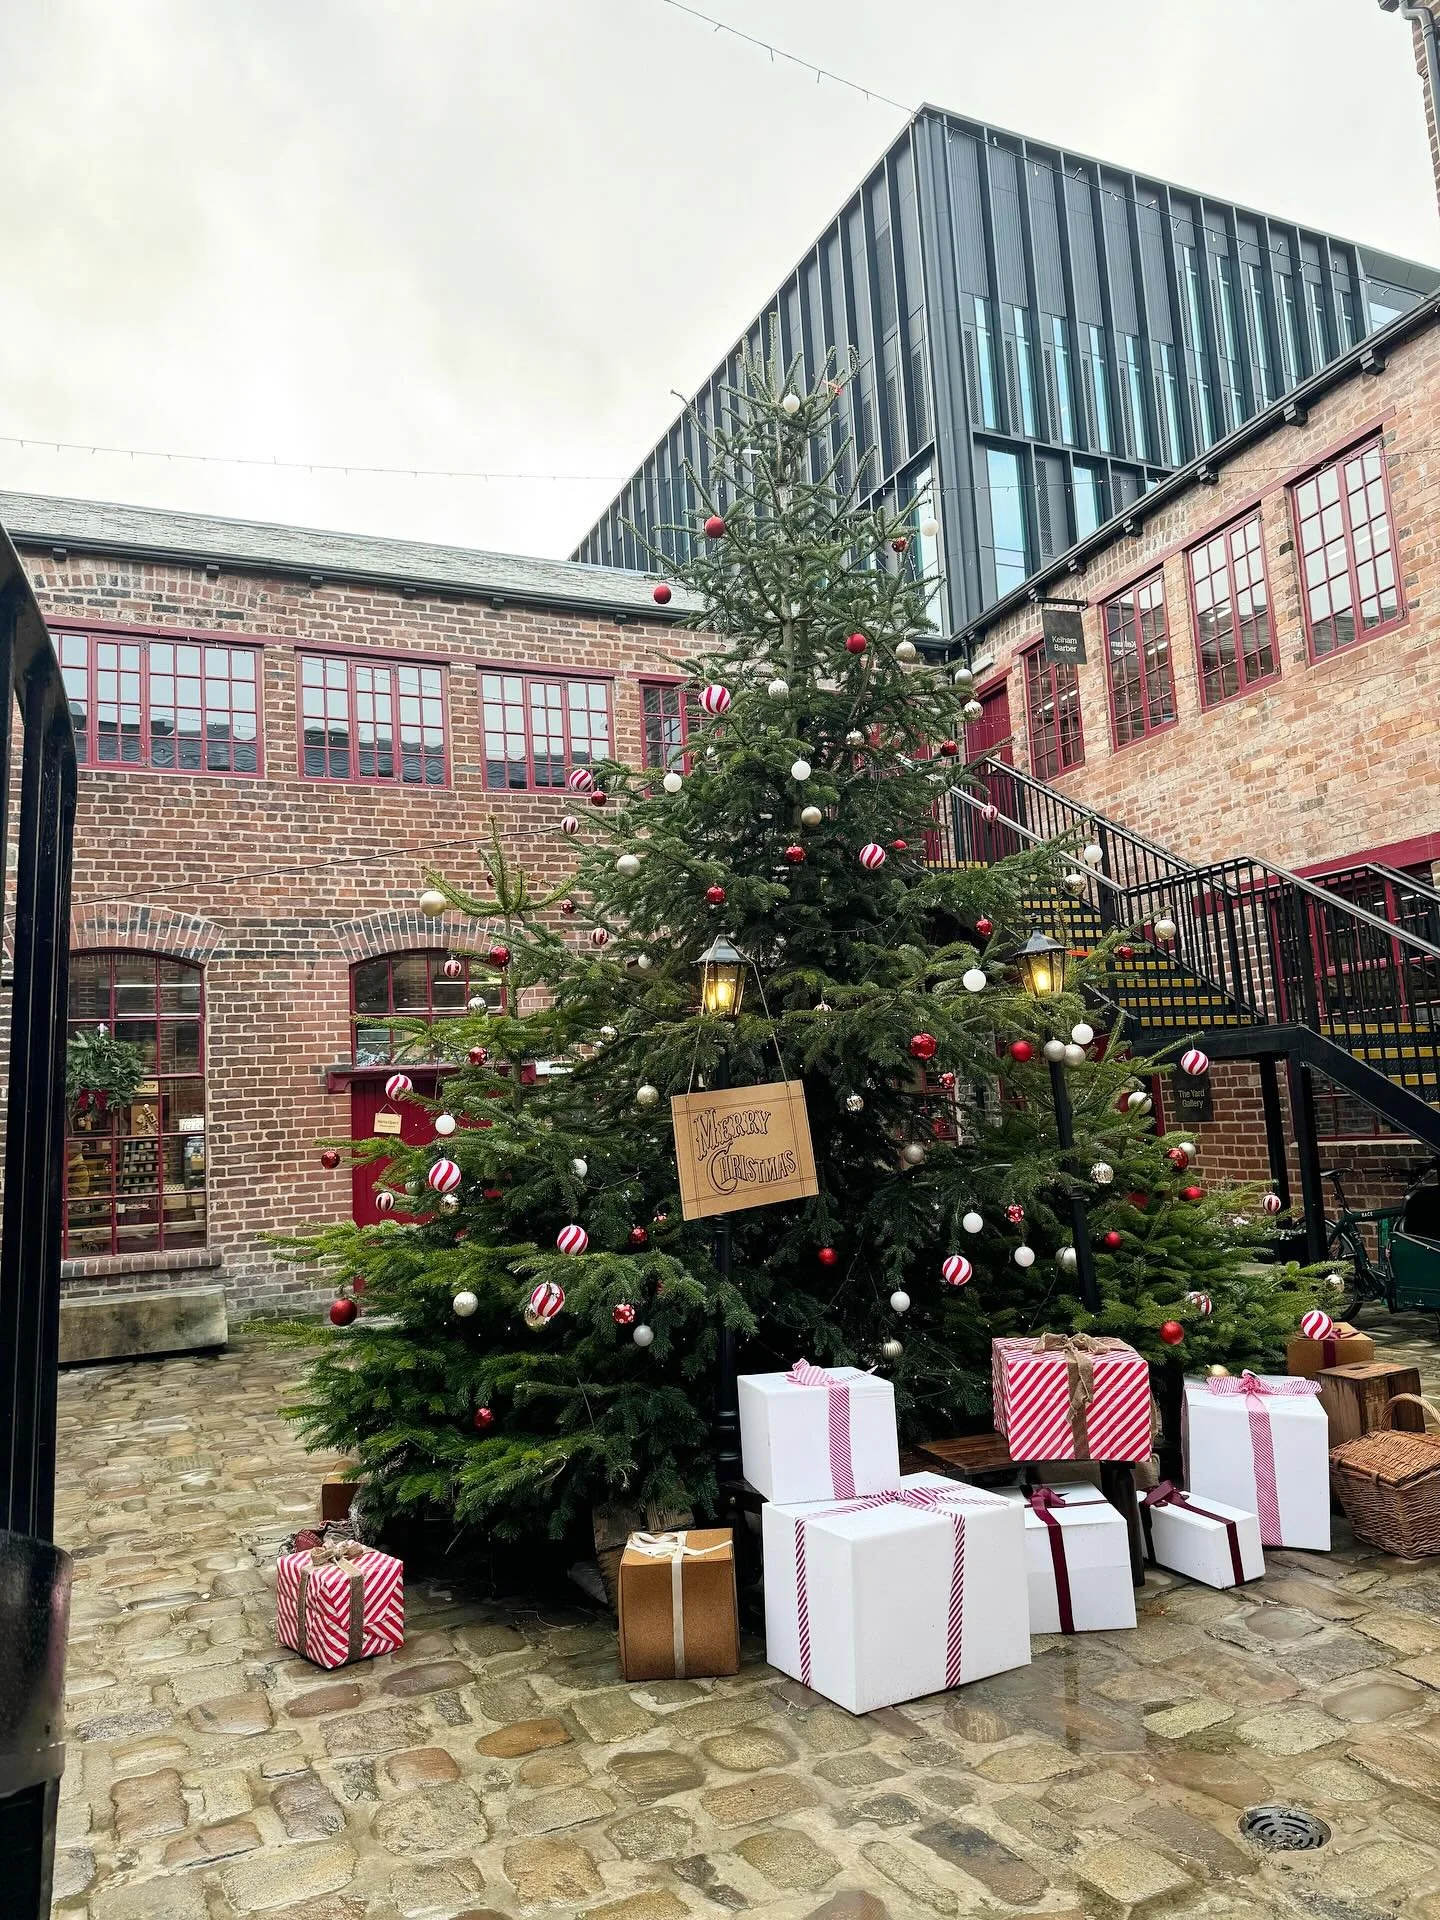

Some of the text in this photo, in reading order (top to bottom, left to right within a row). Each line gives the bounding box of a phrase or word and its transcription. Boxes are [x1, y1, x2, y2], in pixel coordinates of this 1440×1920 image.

[1052, 635, 1077, 645] Kelham
[1054, 644, 1077, 653] Barber
[1178, 1089, 1205, 1098] The Yard
[1182, 1100, 1204, 1109] Gallery
[693, 1107, 771, 1161] MERRY
[706, 1141, 797, 1195] CHRISTMAS
